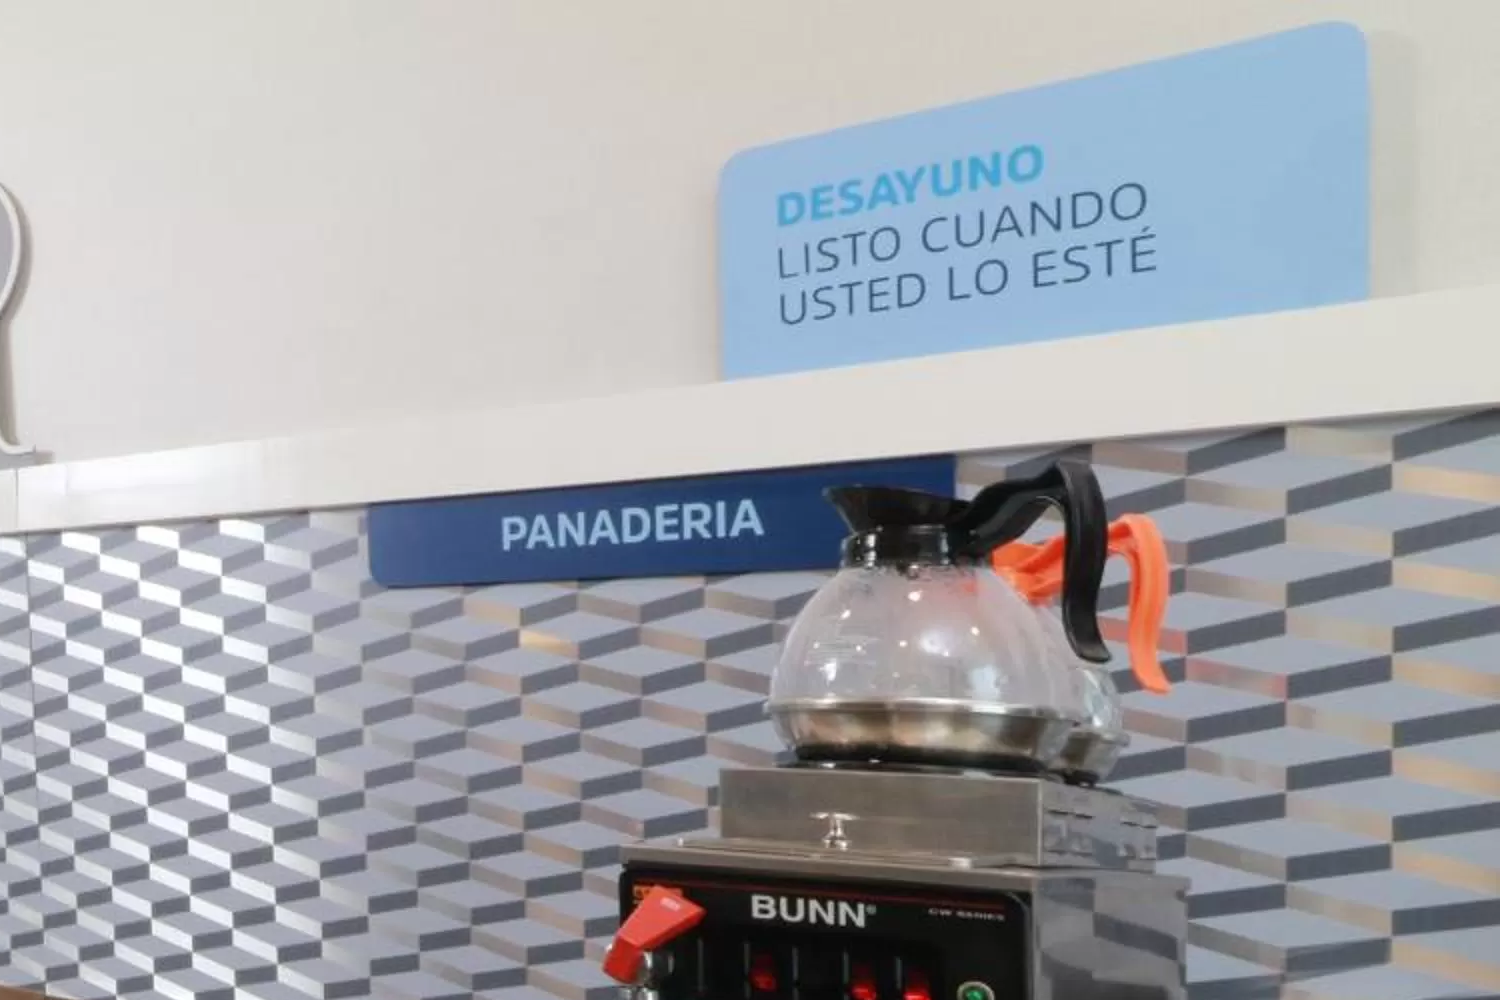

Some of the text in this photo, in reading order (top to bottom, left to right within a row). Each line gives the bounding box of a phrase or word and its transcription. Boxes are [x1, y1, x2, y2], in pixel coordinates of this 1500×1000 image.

[777, 144, 1044, 227] DESAYUNO
[778, 182, 1148, 280] LISTO CUANDO
[779, 226, 1157, 325] USTED LO ESTÉ
[501, 499, 764, 552] PANADERIA
[751, 894, 866, 928] BUNN
